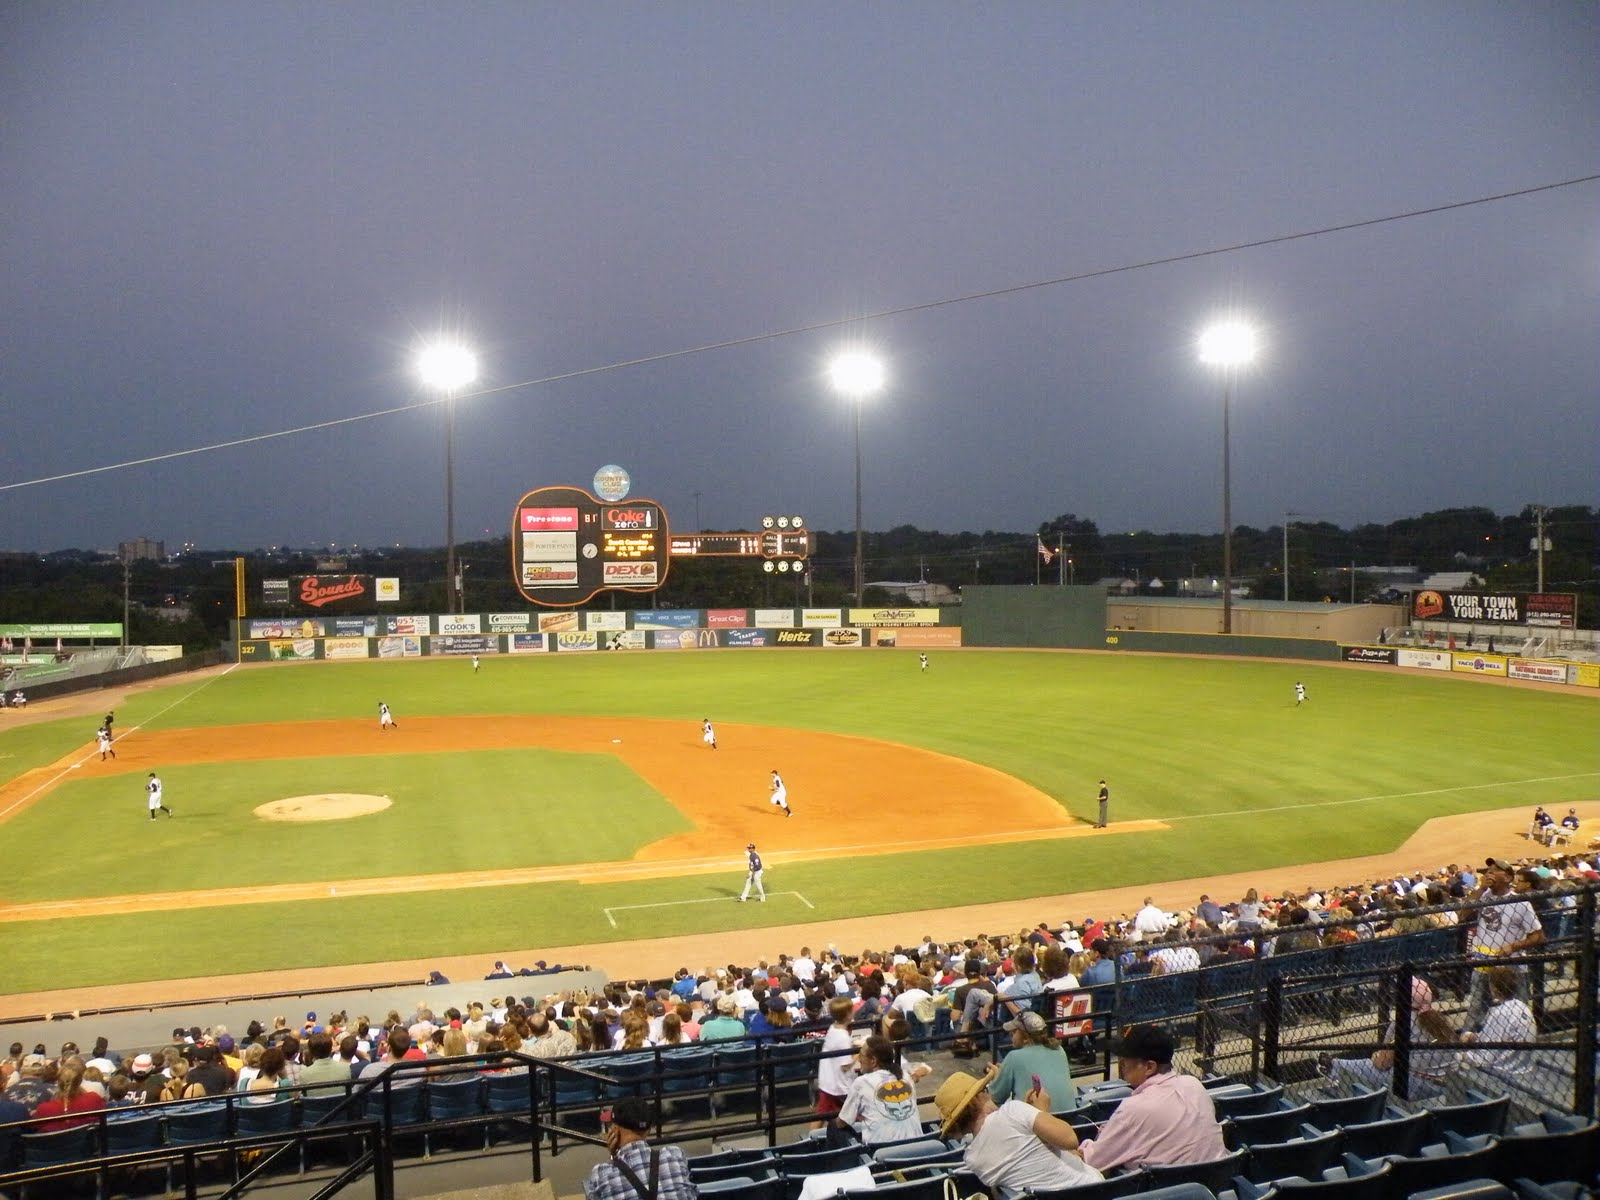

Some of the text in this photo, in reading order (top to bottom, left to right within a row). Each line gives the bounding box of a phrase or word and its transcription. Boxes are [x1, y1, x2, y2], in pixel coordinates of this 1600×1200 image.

[608, 509, 645, 522] Coke
[614, 520, 638, 528] zero
[605, 566, 640, 575] DEX
[300, 576, 364, 601] Sounds
[1450, 595, 1478, 607] YOUR
[1483, 597, 1516, 609] TOWN
[1454, 607, 1518, 620] YOUR TEAM
[560, 633, 596, 644] 107.5
[778, 632, 812, 642] Hertz
[1056, 1000, 1064, 1033] SETION
